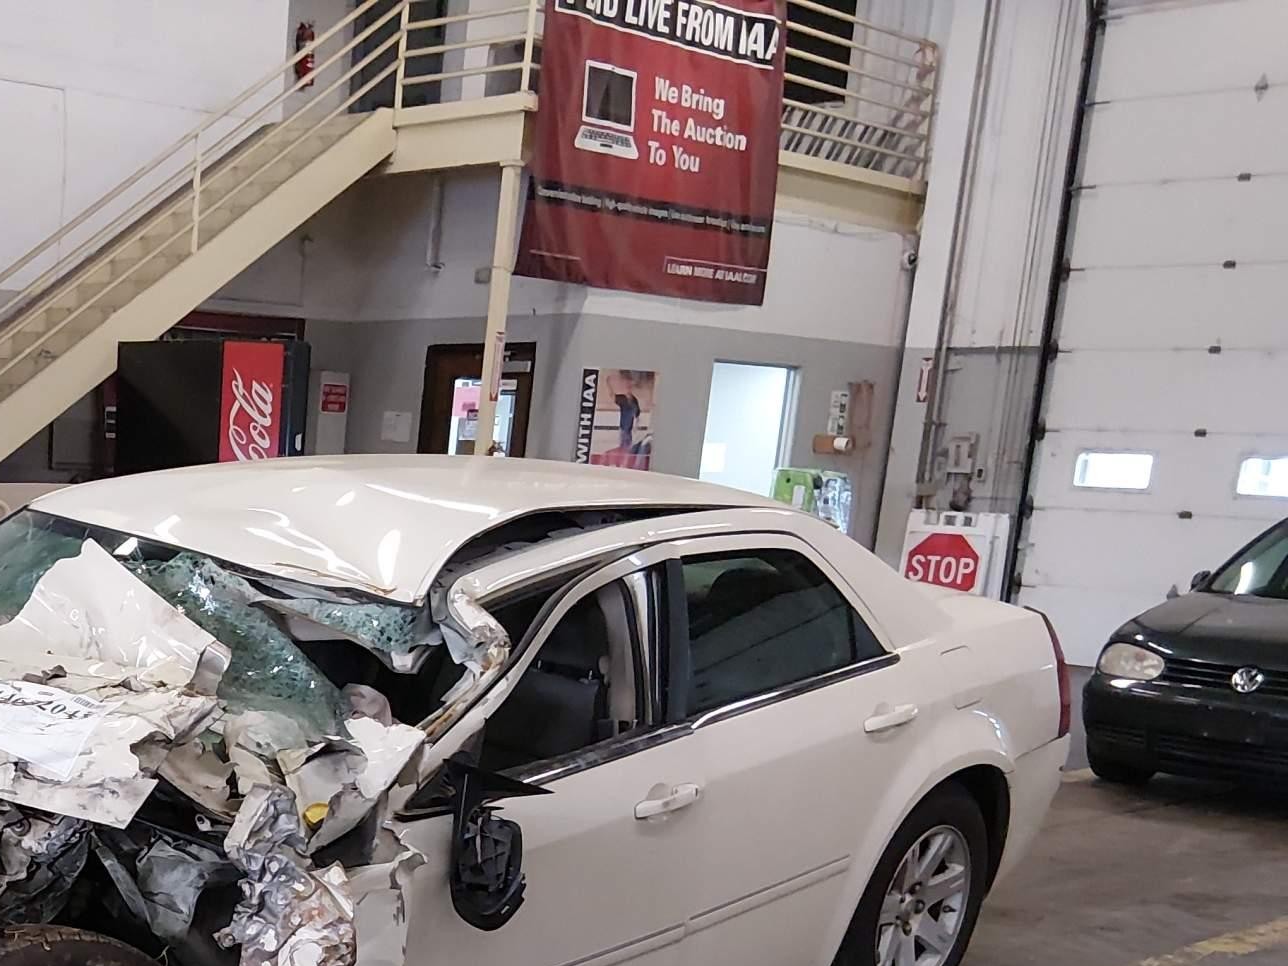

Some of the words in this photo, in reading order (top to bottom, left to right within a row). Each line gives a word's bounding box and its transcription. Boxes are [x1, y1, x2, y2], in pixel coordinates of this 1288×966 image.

[624, 0, 673, 34] LIVE
[676, 1, 735, 52] FROM
[655, 76, 679, 104] We
[681, 84, 726, 120] Bring
[651, 108, 681, 137] The
[683, 117, 747, 151] Auction
[648, 140, 667, 166] To
[672, 144, 700, 173] You
[582, 374, 597, 408] IAA
[575, 413, 592, 464] WITH
[908, 554, 975, 585] STOP
